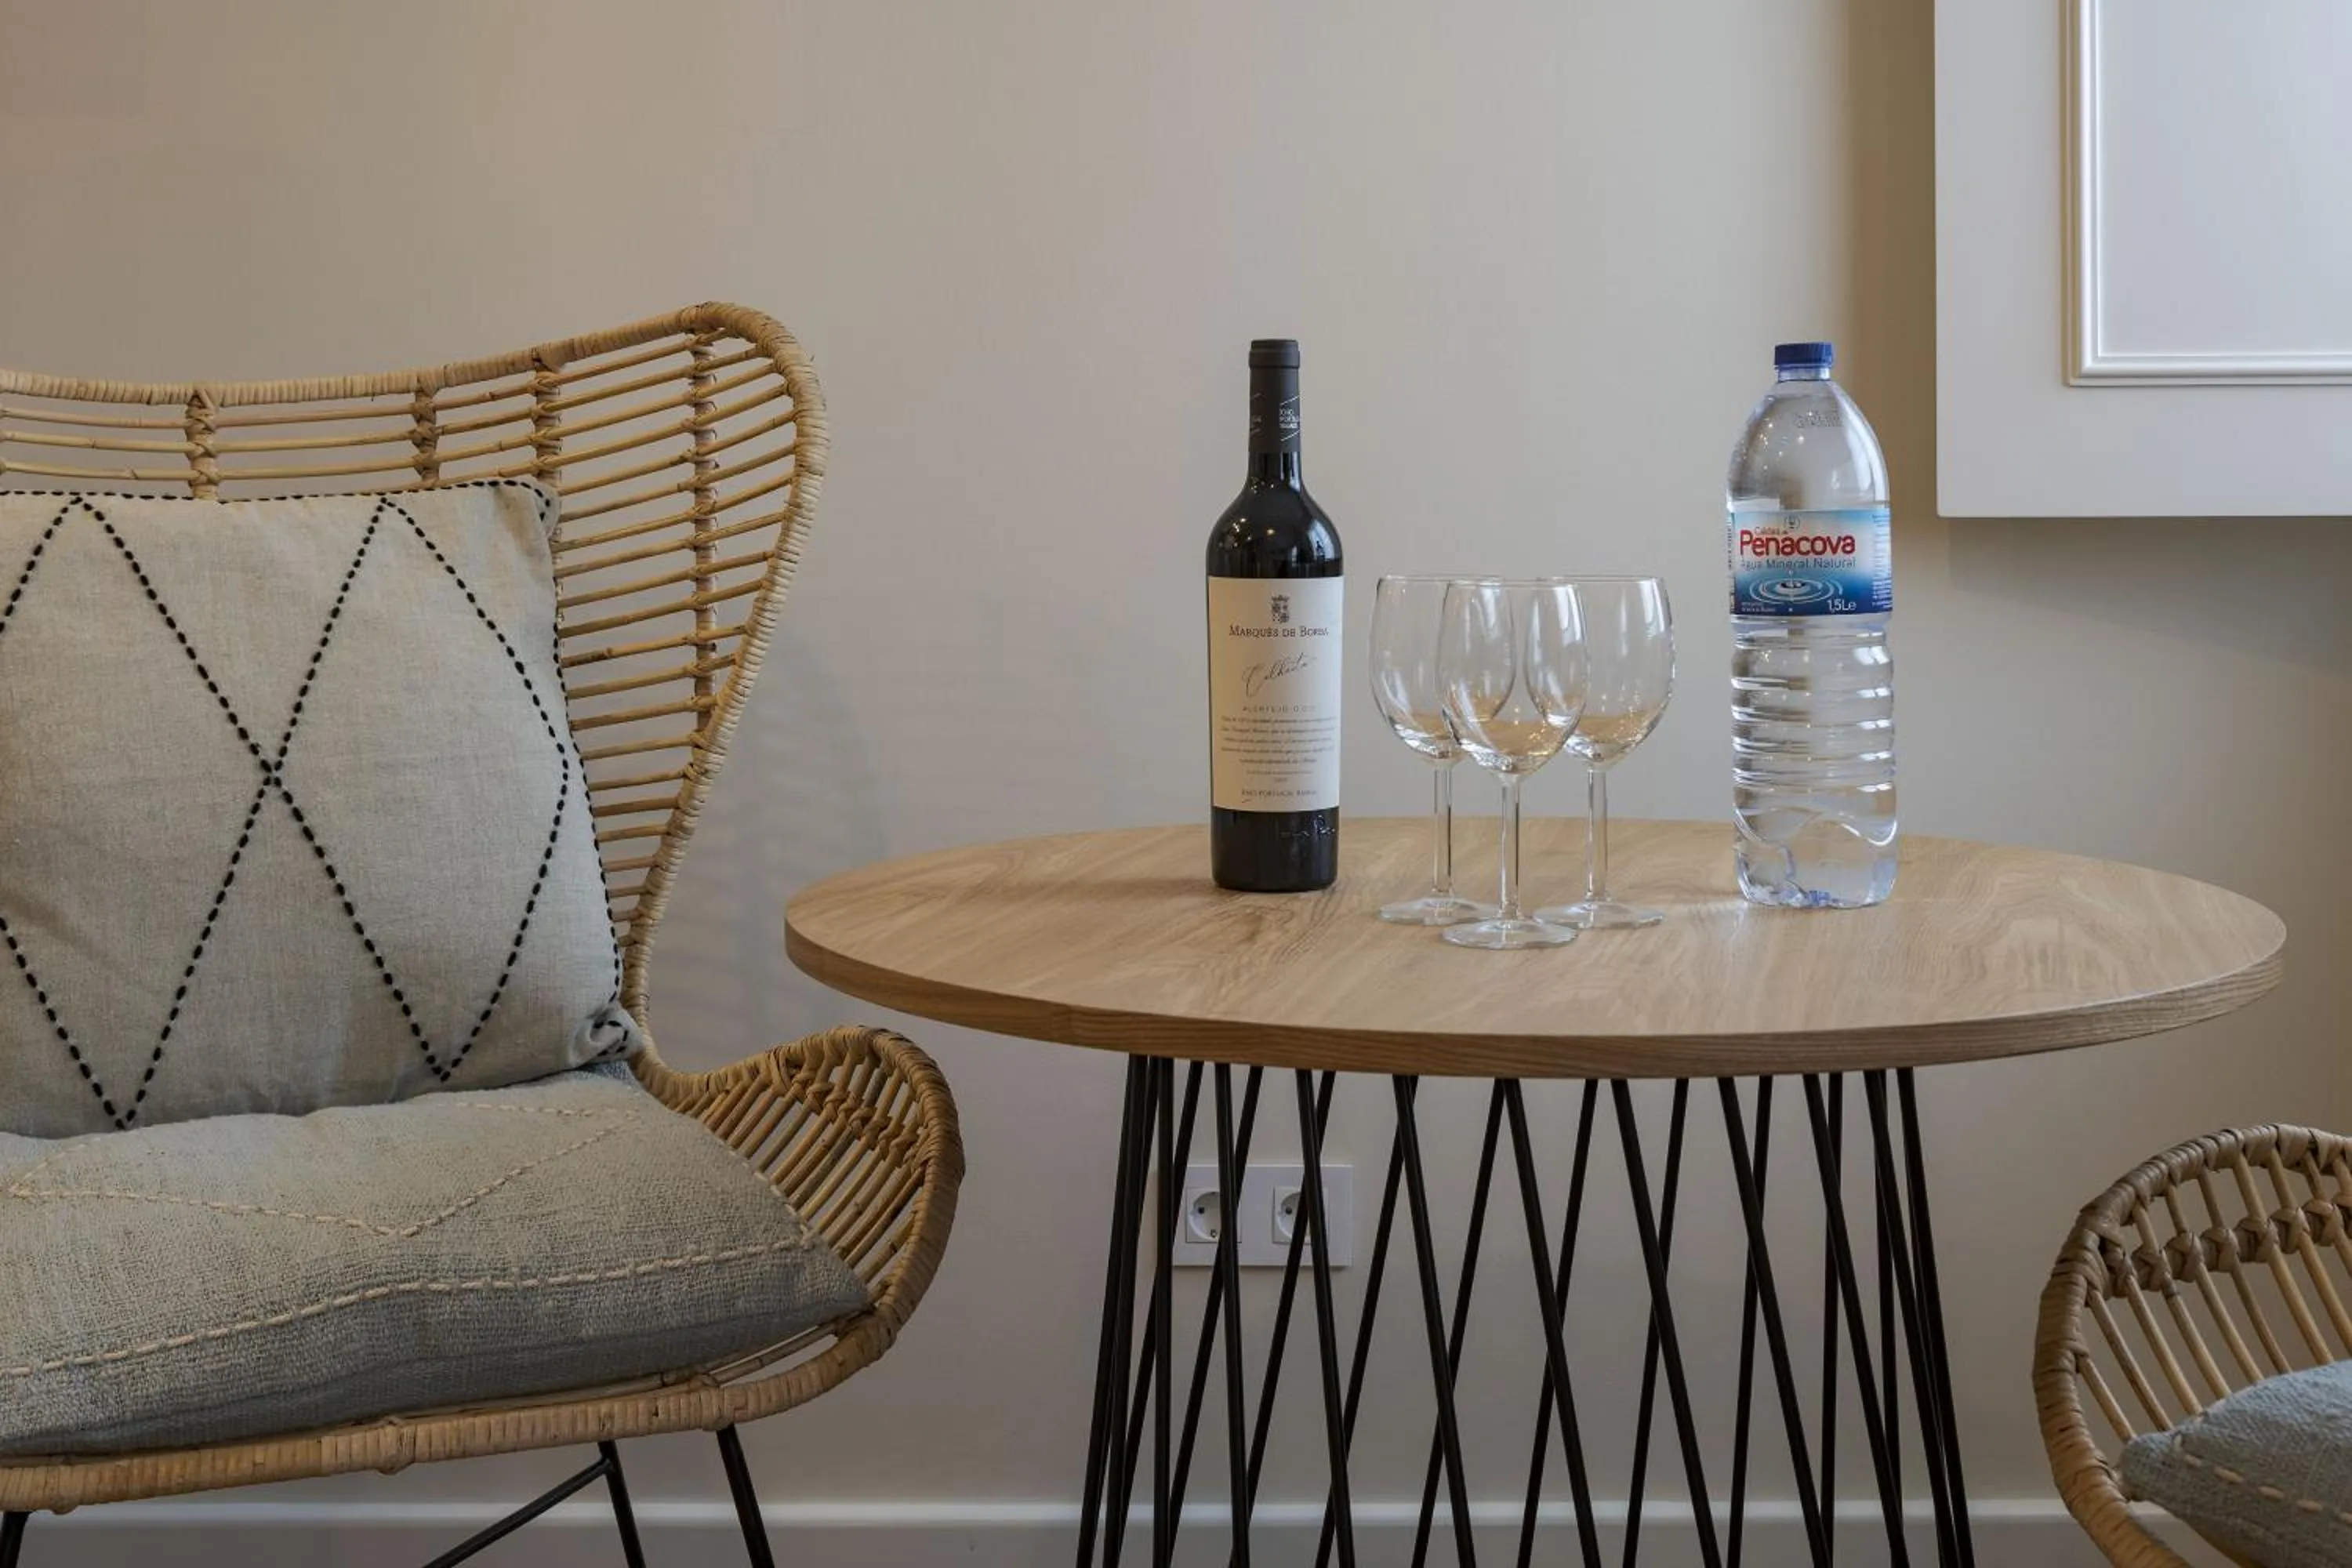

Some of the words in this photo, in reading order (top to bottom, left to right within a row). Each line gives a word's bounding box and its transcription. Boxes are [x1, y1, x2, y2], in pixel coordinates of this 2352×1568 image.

[1740, 528, 1857, 557] Penacova
[1766, 559, 1809, 569] Mineral
[1813, 557, 1857, 569] Natural
[1282, 627, 1296, 637] DE
